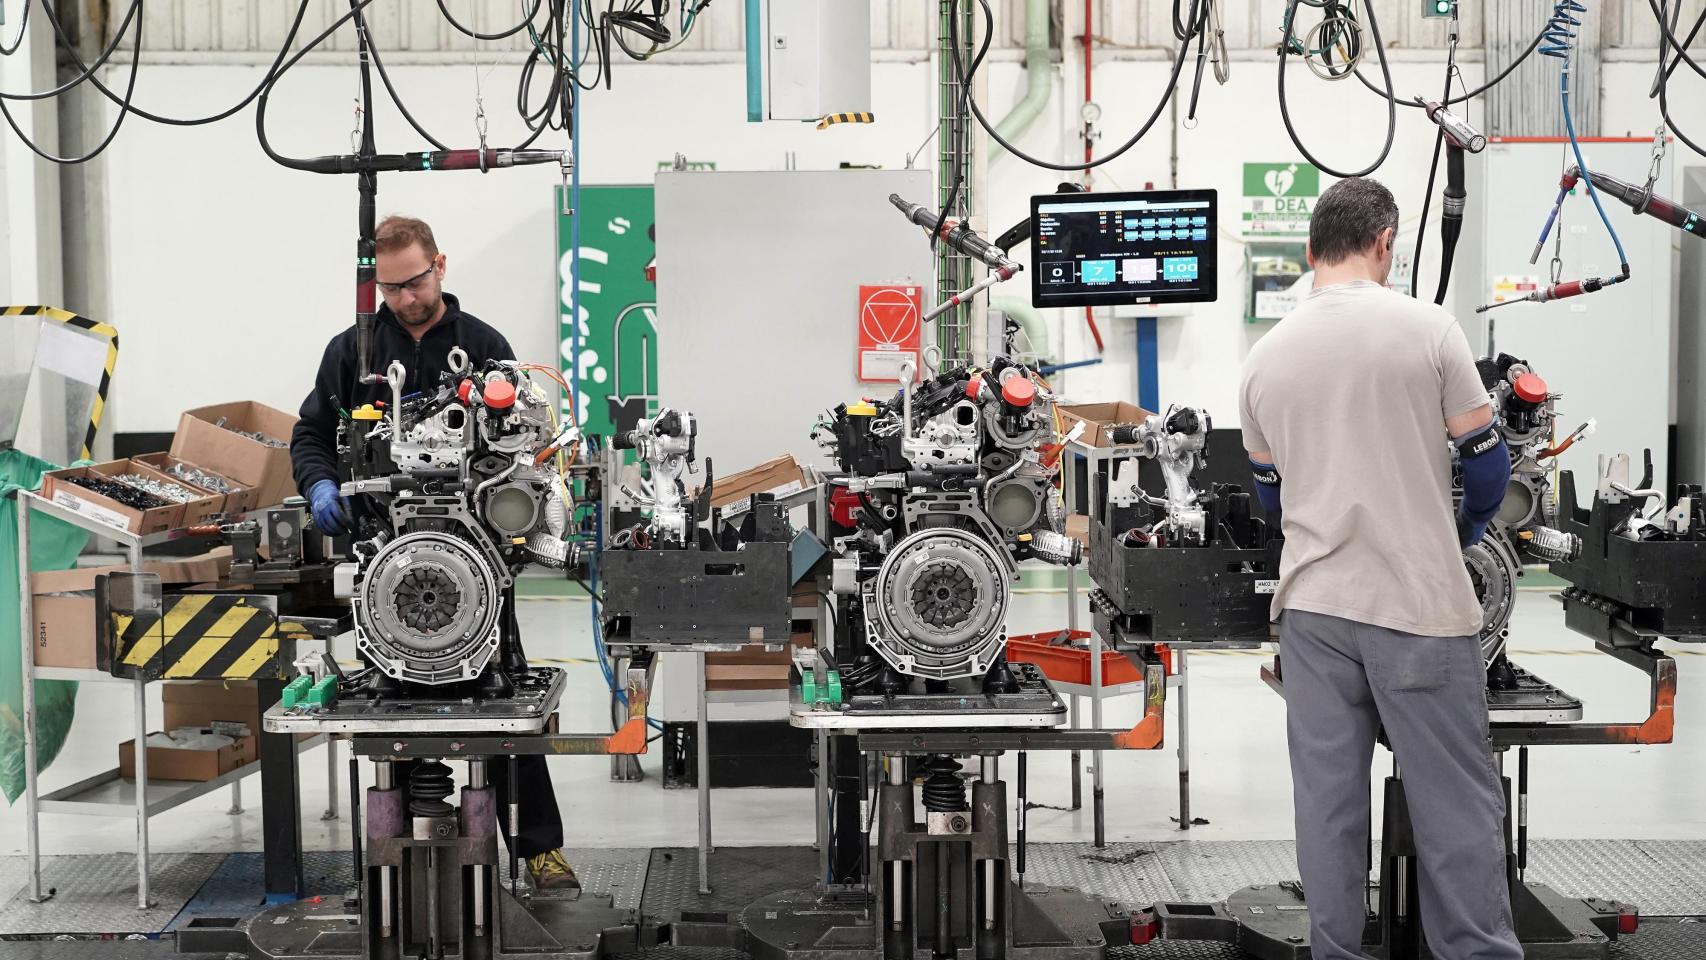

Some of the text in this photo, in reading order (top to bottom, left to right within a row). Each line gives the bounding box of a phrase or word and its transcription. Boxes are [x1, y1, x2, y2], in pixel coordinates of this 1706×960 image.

[1275, 198, 1308, 211] DEA
[1052, 268, 1063, 277] 0
[1093, 266, 1104, 276] 7
[1167, 263, 1197, 273] 100
[1473, 436, 1498, 454] LEBON
